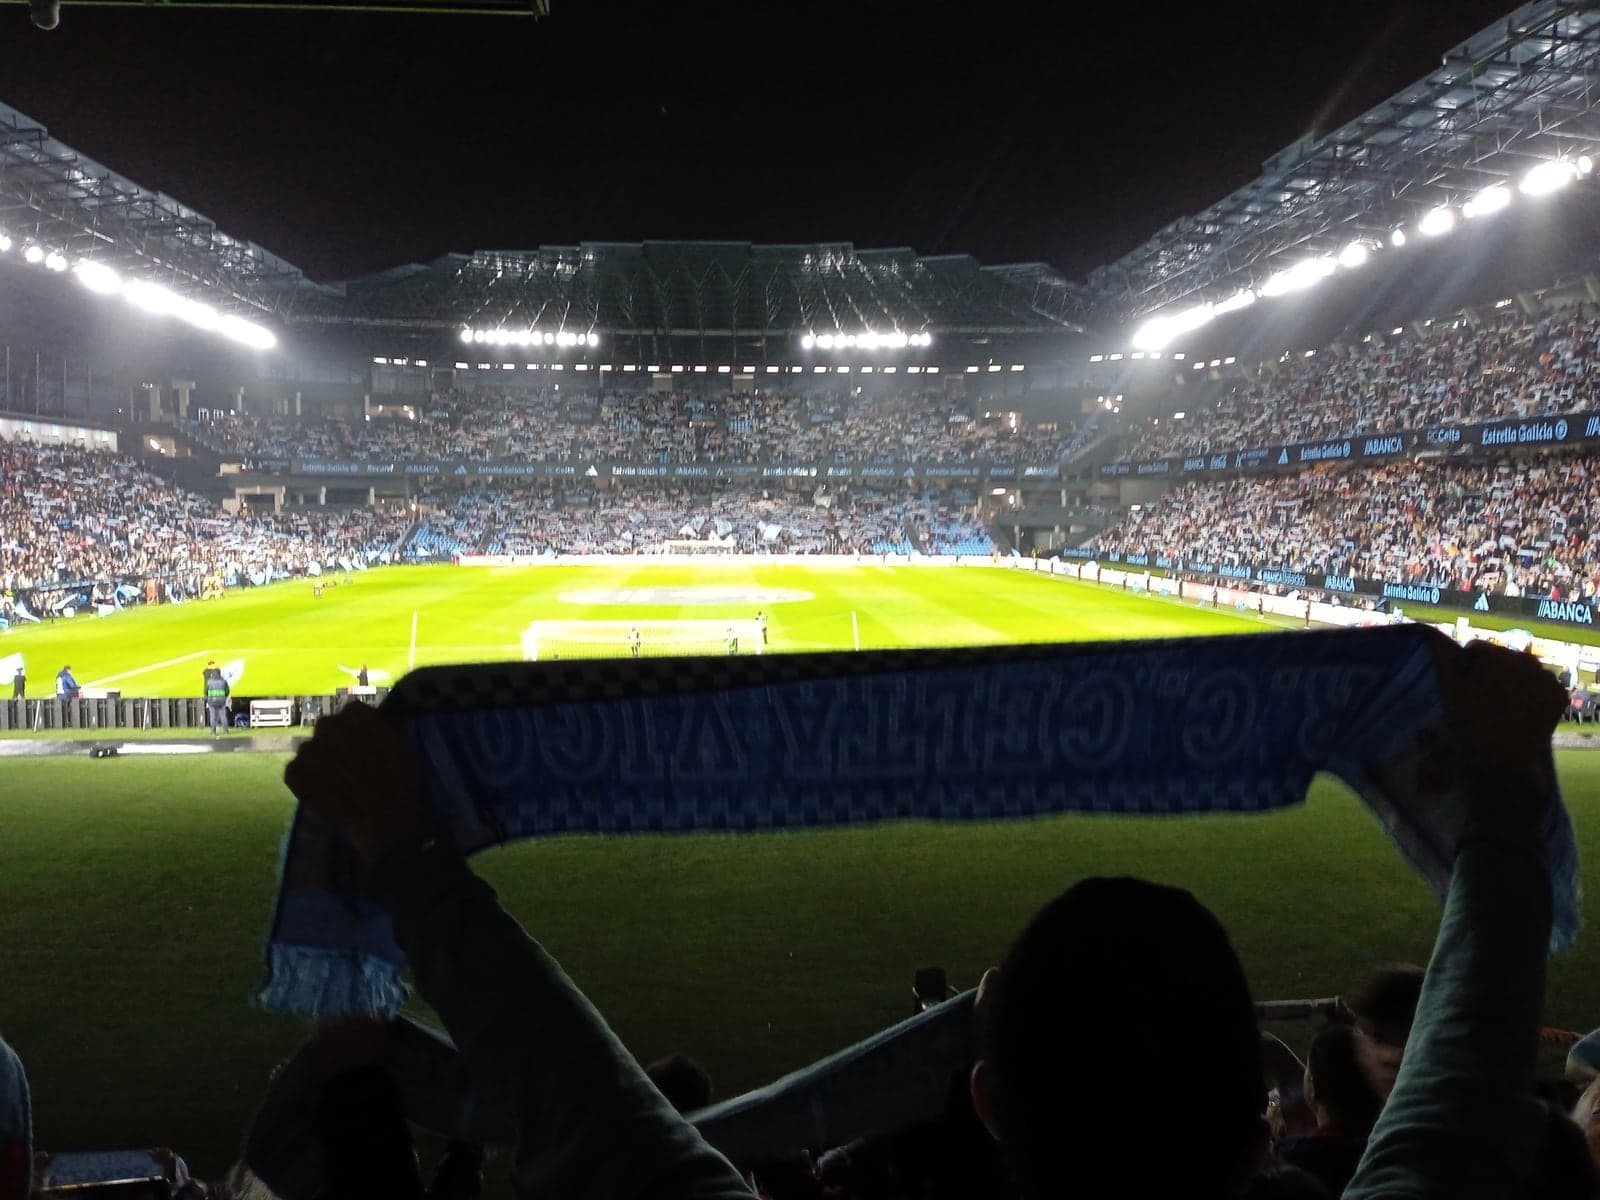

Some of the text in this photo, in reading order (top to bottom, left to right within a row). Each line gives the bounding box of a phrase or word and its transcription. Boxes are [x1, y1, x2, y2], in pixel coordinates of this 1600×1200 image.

[1481, 421, 1552, 444] Estrella Galicia
[466, 694, 748, 786] VIGO
[768, 668, 1136, 779] CELTA
